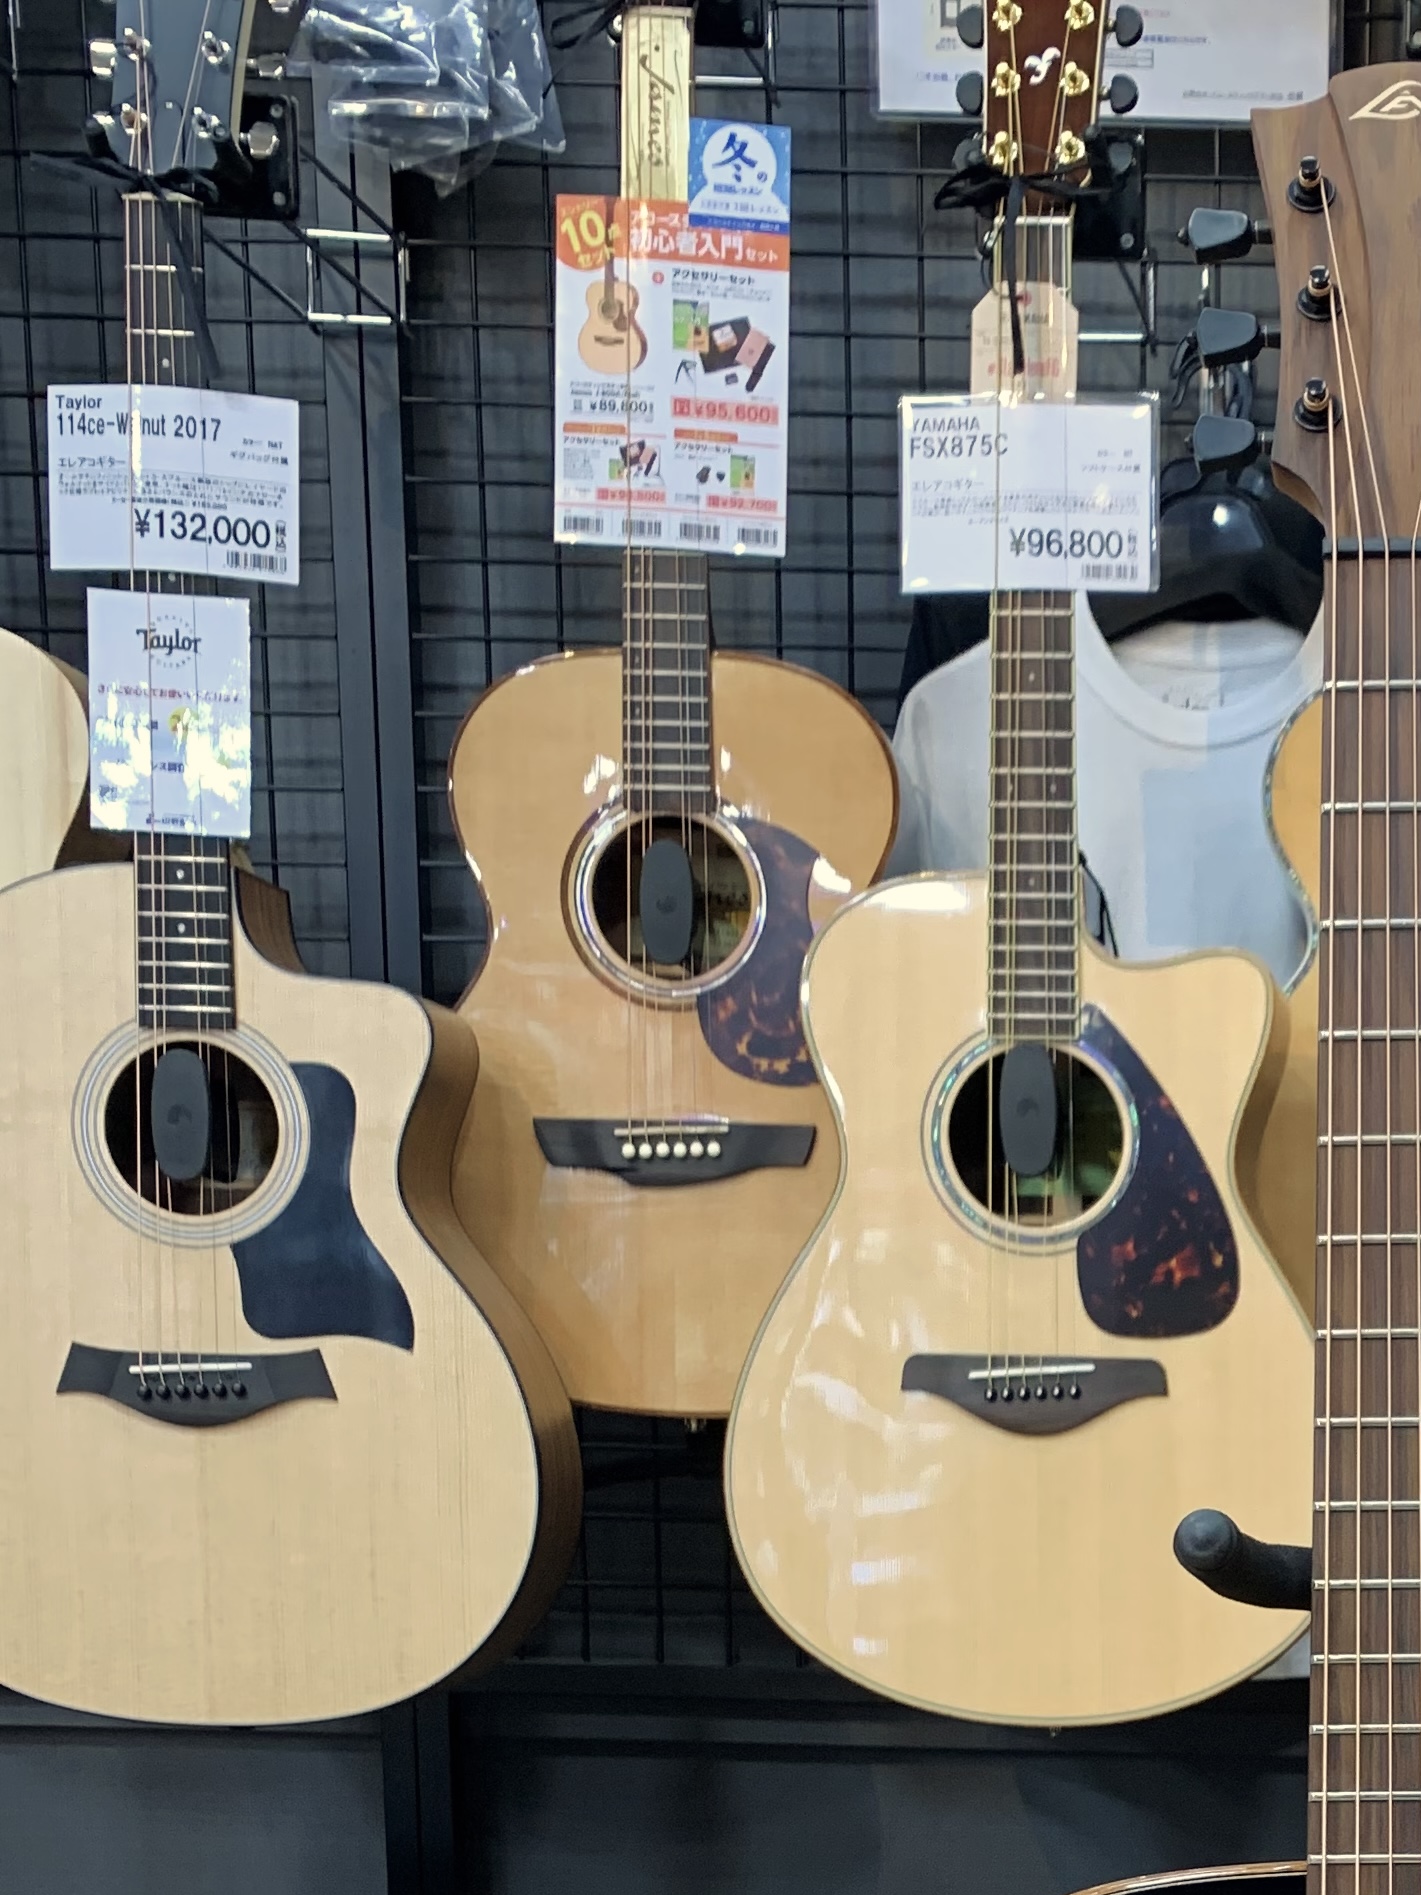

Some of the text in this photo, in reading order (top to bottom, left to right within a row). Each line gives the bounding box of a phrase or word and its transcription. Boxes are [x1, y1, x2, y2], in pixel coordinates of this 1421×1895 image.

[56, 395, 102, 410] Taylor
[57, 412, 222, 442] 114ce-Wnut 2017
[911, 416, 980, 432] YAMAHA
[909, 433, 1009, 459] FSX875C
[59, 456, 126, 468] エレアコギター
[134, 508, 270, 548] ¥132,000
[1009, 527, 1123, 559] ¥96,800
[136, 627, 202, 656] Taylor
